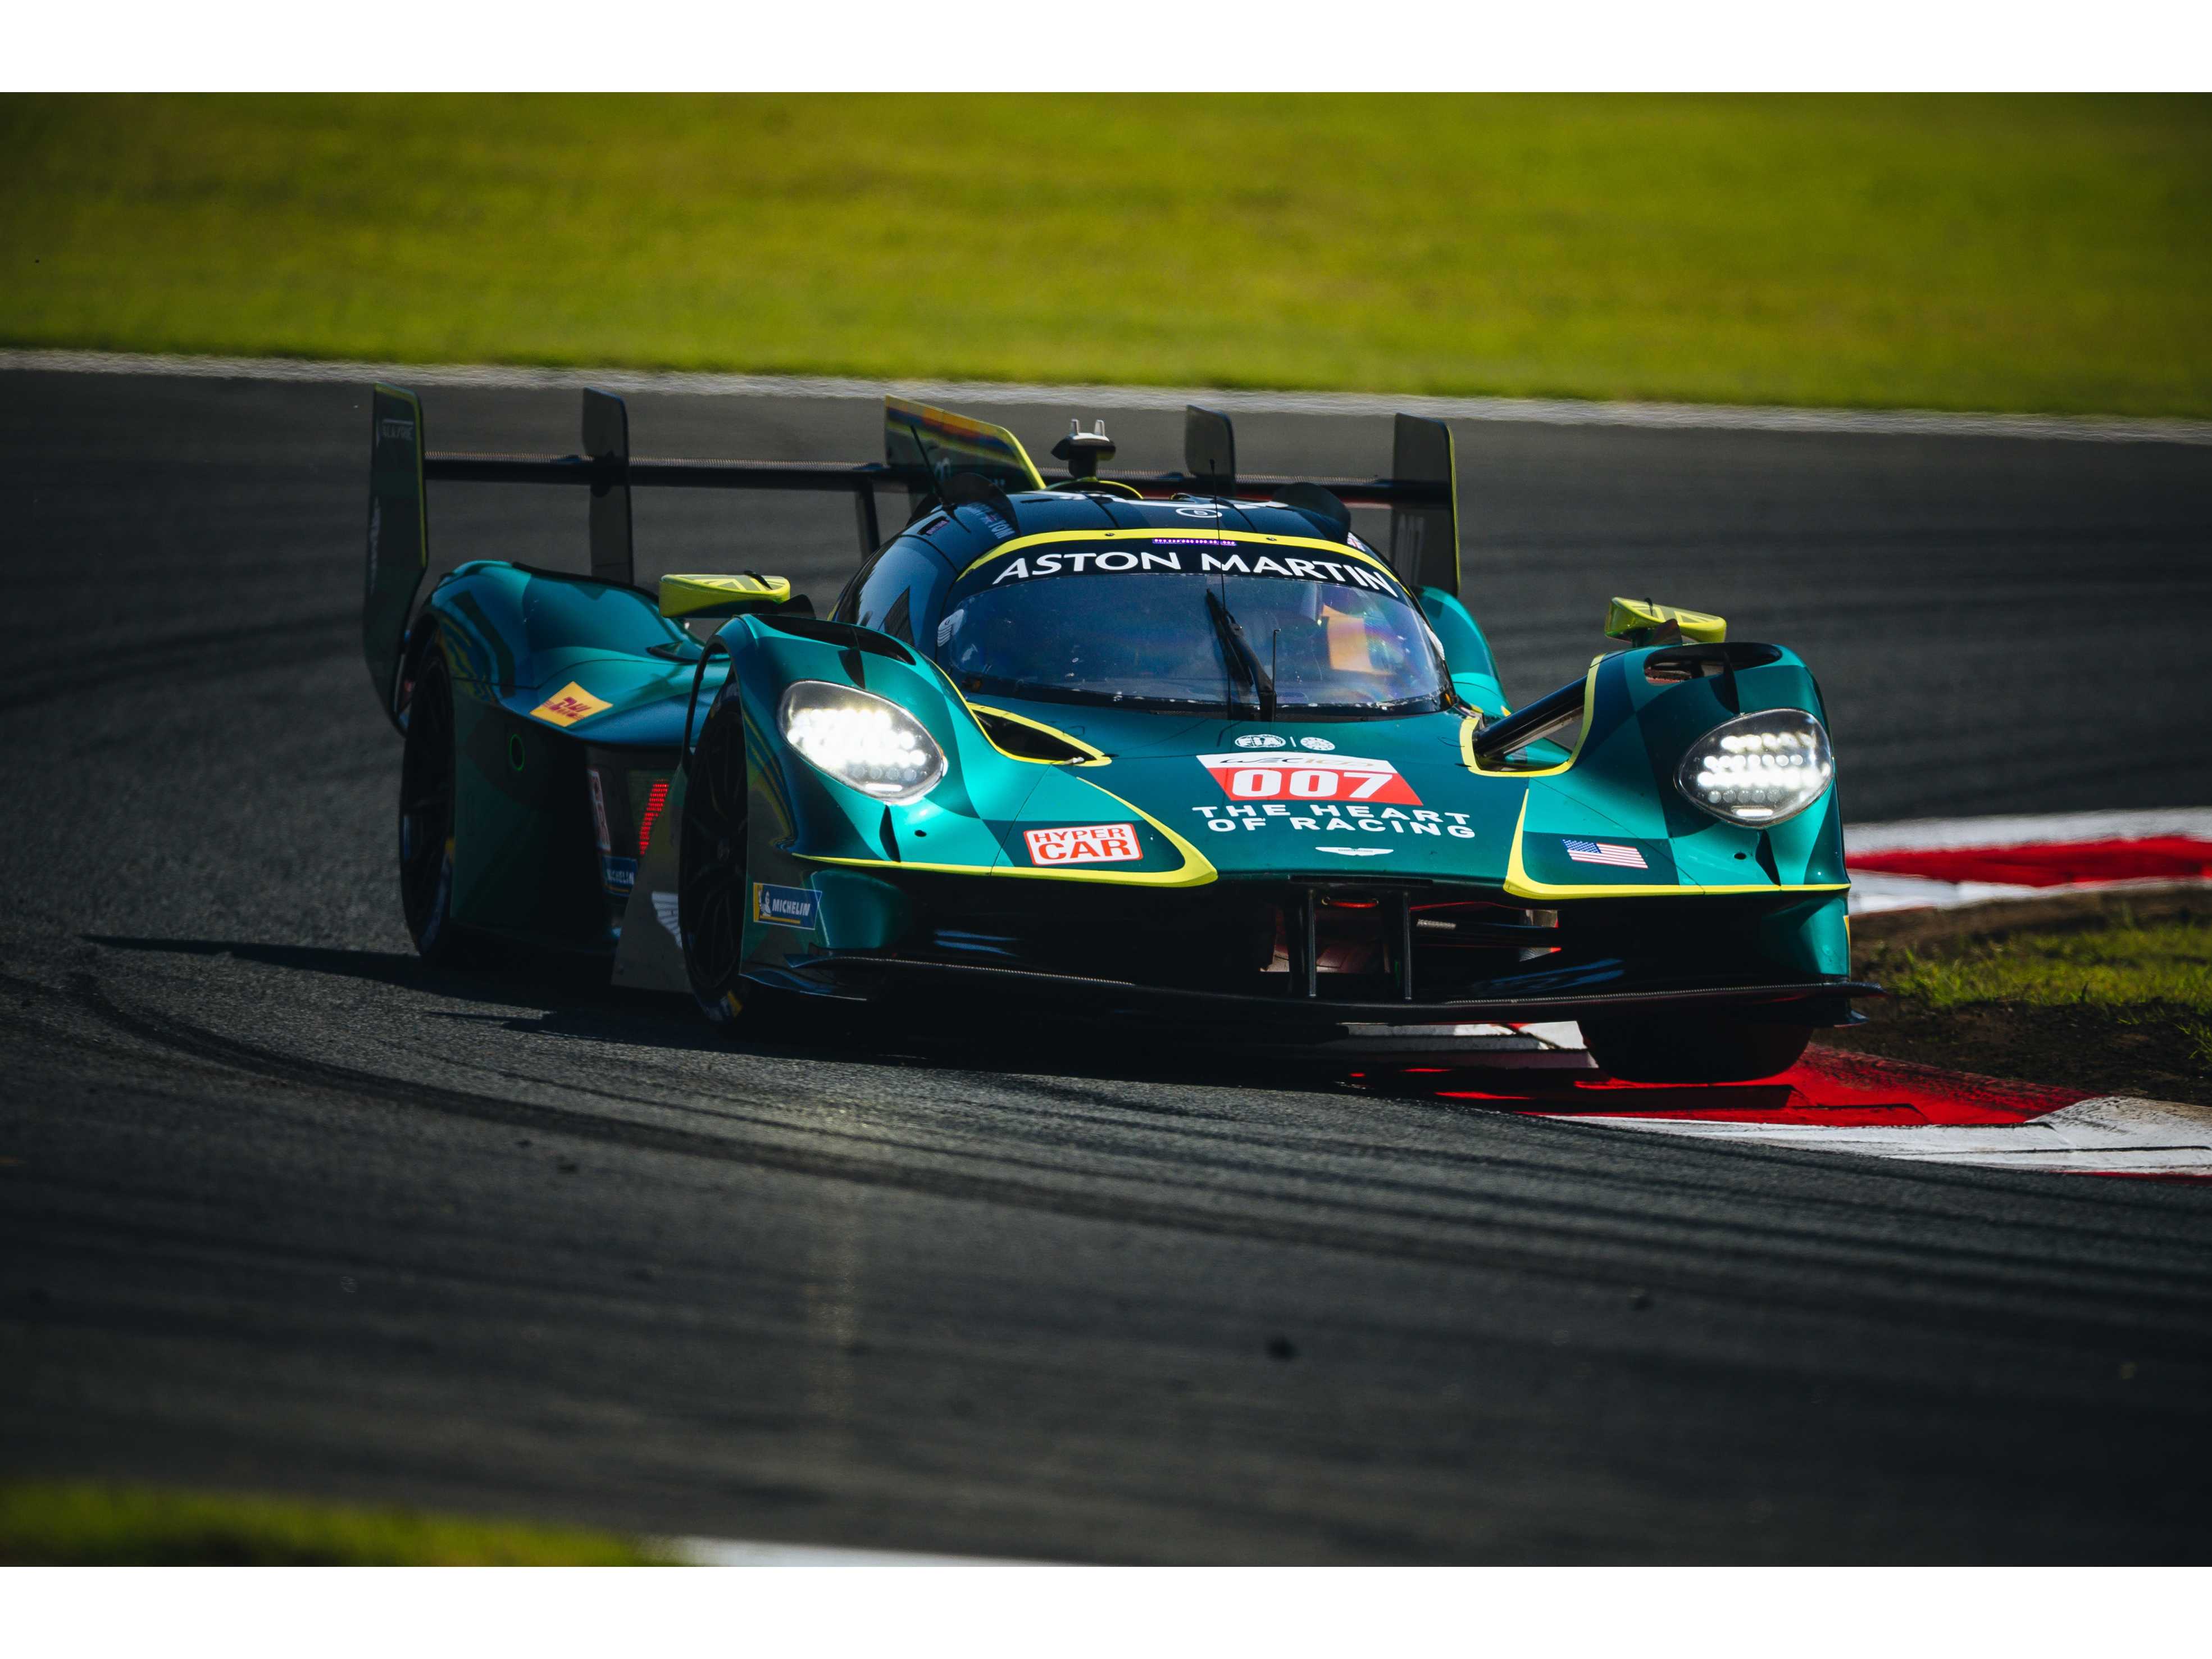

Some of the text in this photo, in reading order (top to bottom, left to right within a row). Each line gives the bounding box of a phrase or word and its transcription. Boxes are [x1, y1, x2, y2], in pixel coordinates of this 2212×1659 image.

[992, 552, 1398, 598] ASTON MARTIN
[1237, 736, 1281, 747] FIA
[1232, 769, 1393, 799] 007
[1192, 804, 1470, 825] THE HEART
[1034, 828, 1126, 843] HYPER
[1208, 817, 1475, 838] OF RACING
[1038, 839, 1132, 860] CAR
[772, 898, 811, 916] MICHELIN
